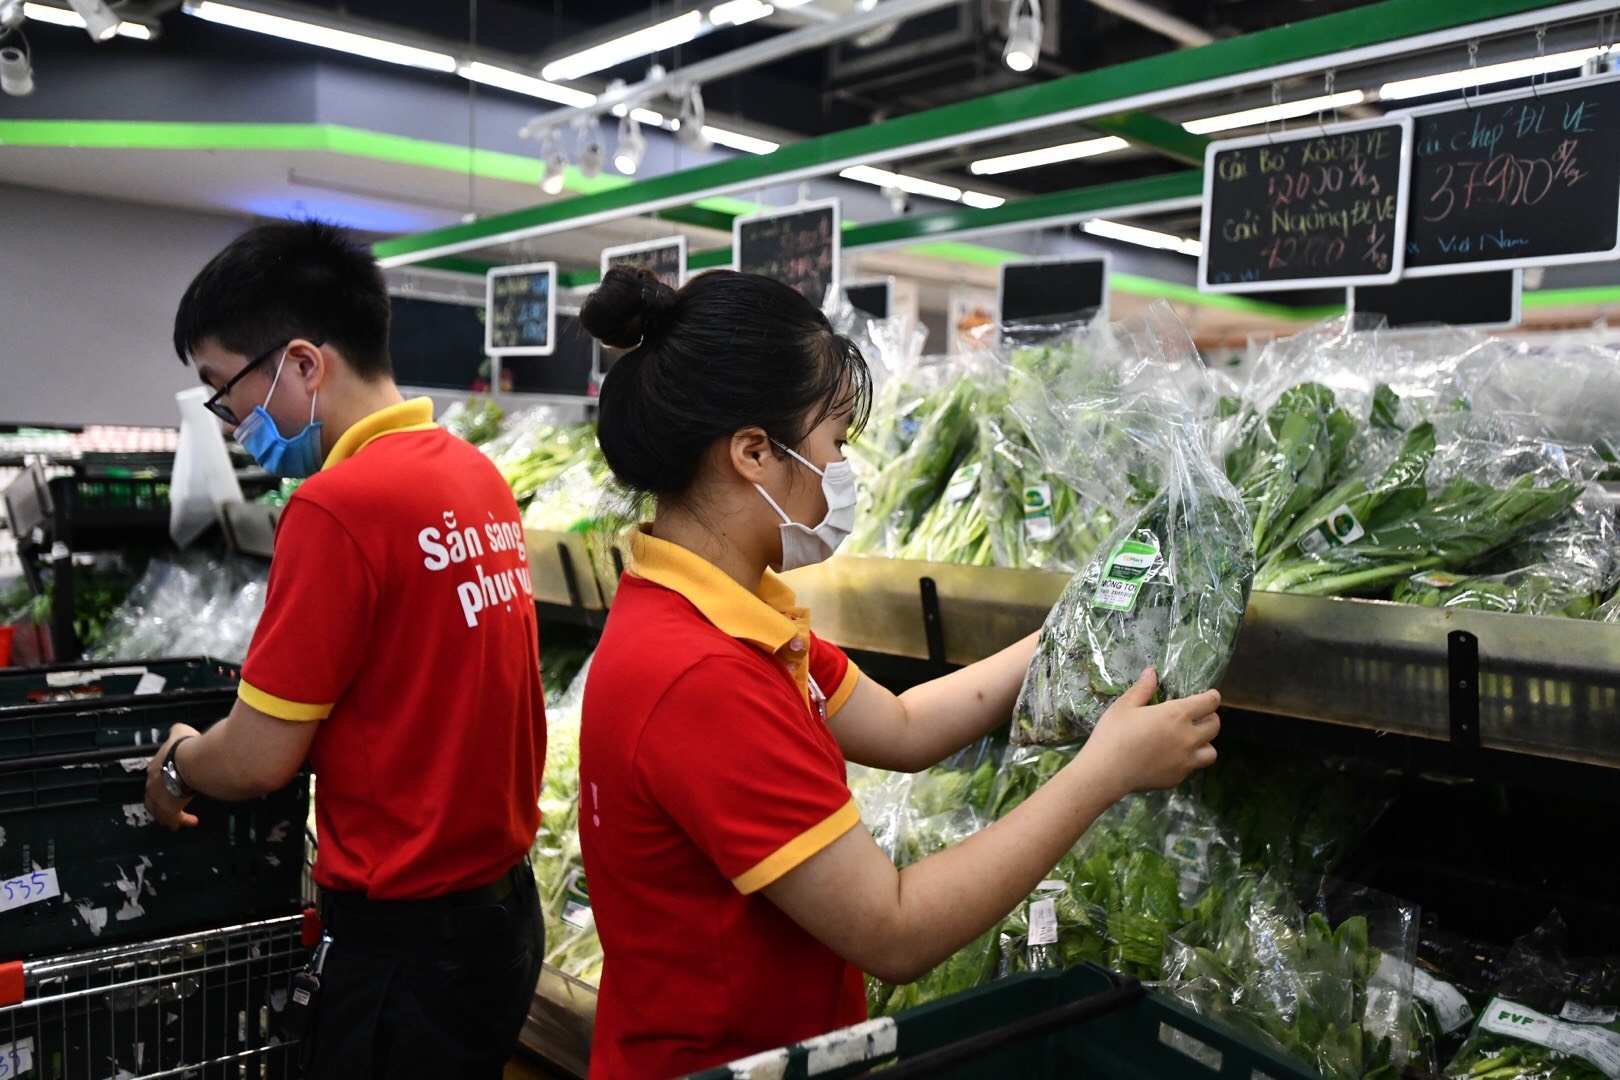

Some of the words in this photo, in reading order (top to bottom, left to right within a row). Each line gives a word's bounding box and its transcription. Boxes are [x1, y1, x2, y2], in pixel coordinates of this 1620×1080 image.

[418, 510, 484, 571] Sẵn
[484, 511, 526, 562] sàng
[1498, 1010, 1535, 1025] FVF
